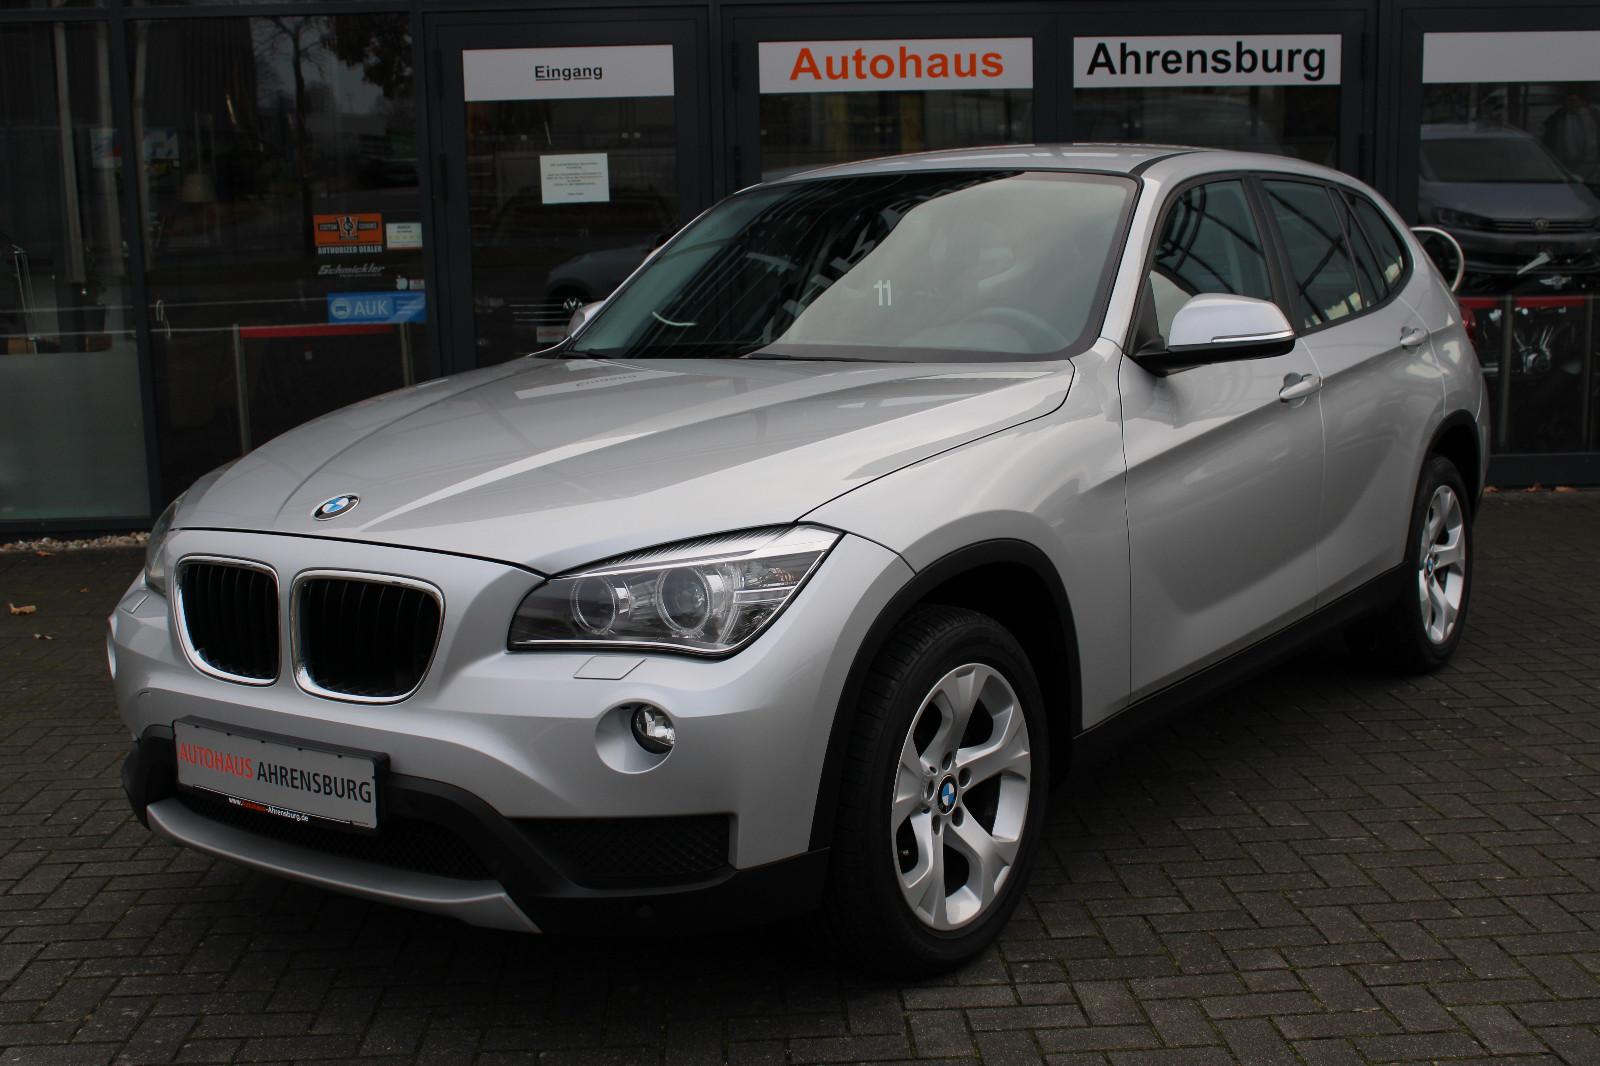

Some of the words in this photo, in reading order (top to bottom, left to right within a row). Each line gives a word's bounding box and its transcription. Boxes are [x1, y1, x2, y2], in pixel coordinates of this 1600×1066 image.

[790, 46, 1004, 80] Autohaus
[1087, 41, 1326, 81] Ahrensburg
[535, 65, 602, 81] Eingang
[318, 246, 357, 255] AUTHORIZED
[359, 245, 382, 254] DEALER
[318, 262, 385, 275] Schmickler
[354, 300, 388, 315] AUK
[179, 742, 254, 779] AUTOHAUS
[257, 762, 371, 803] AHRENSBURG
